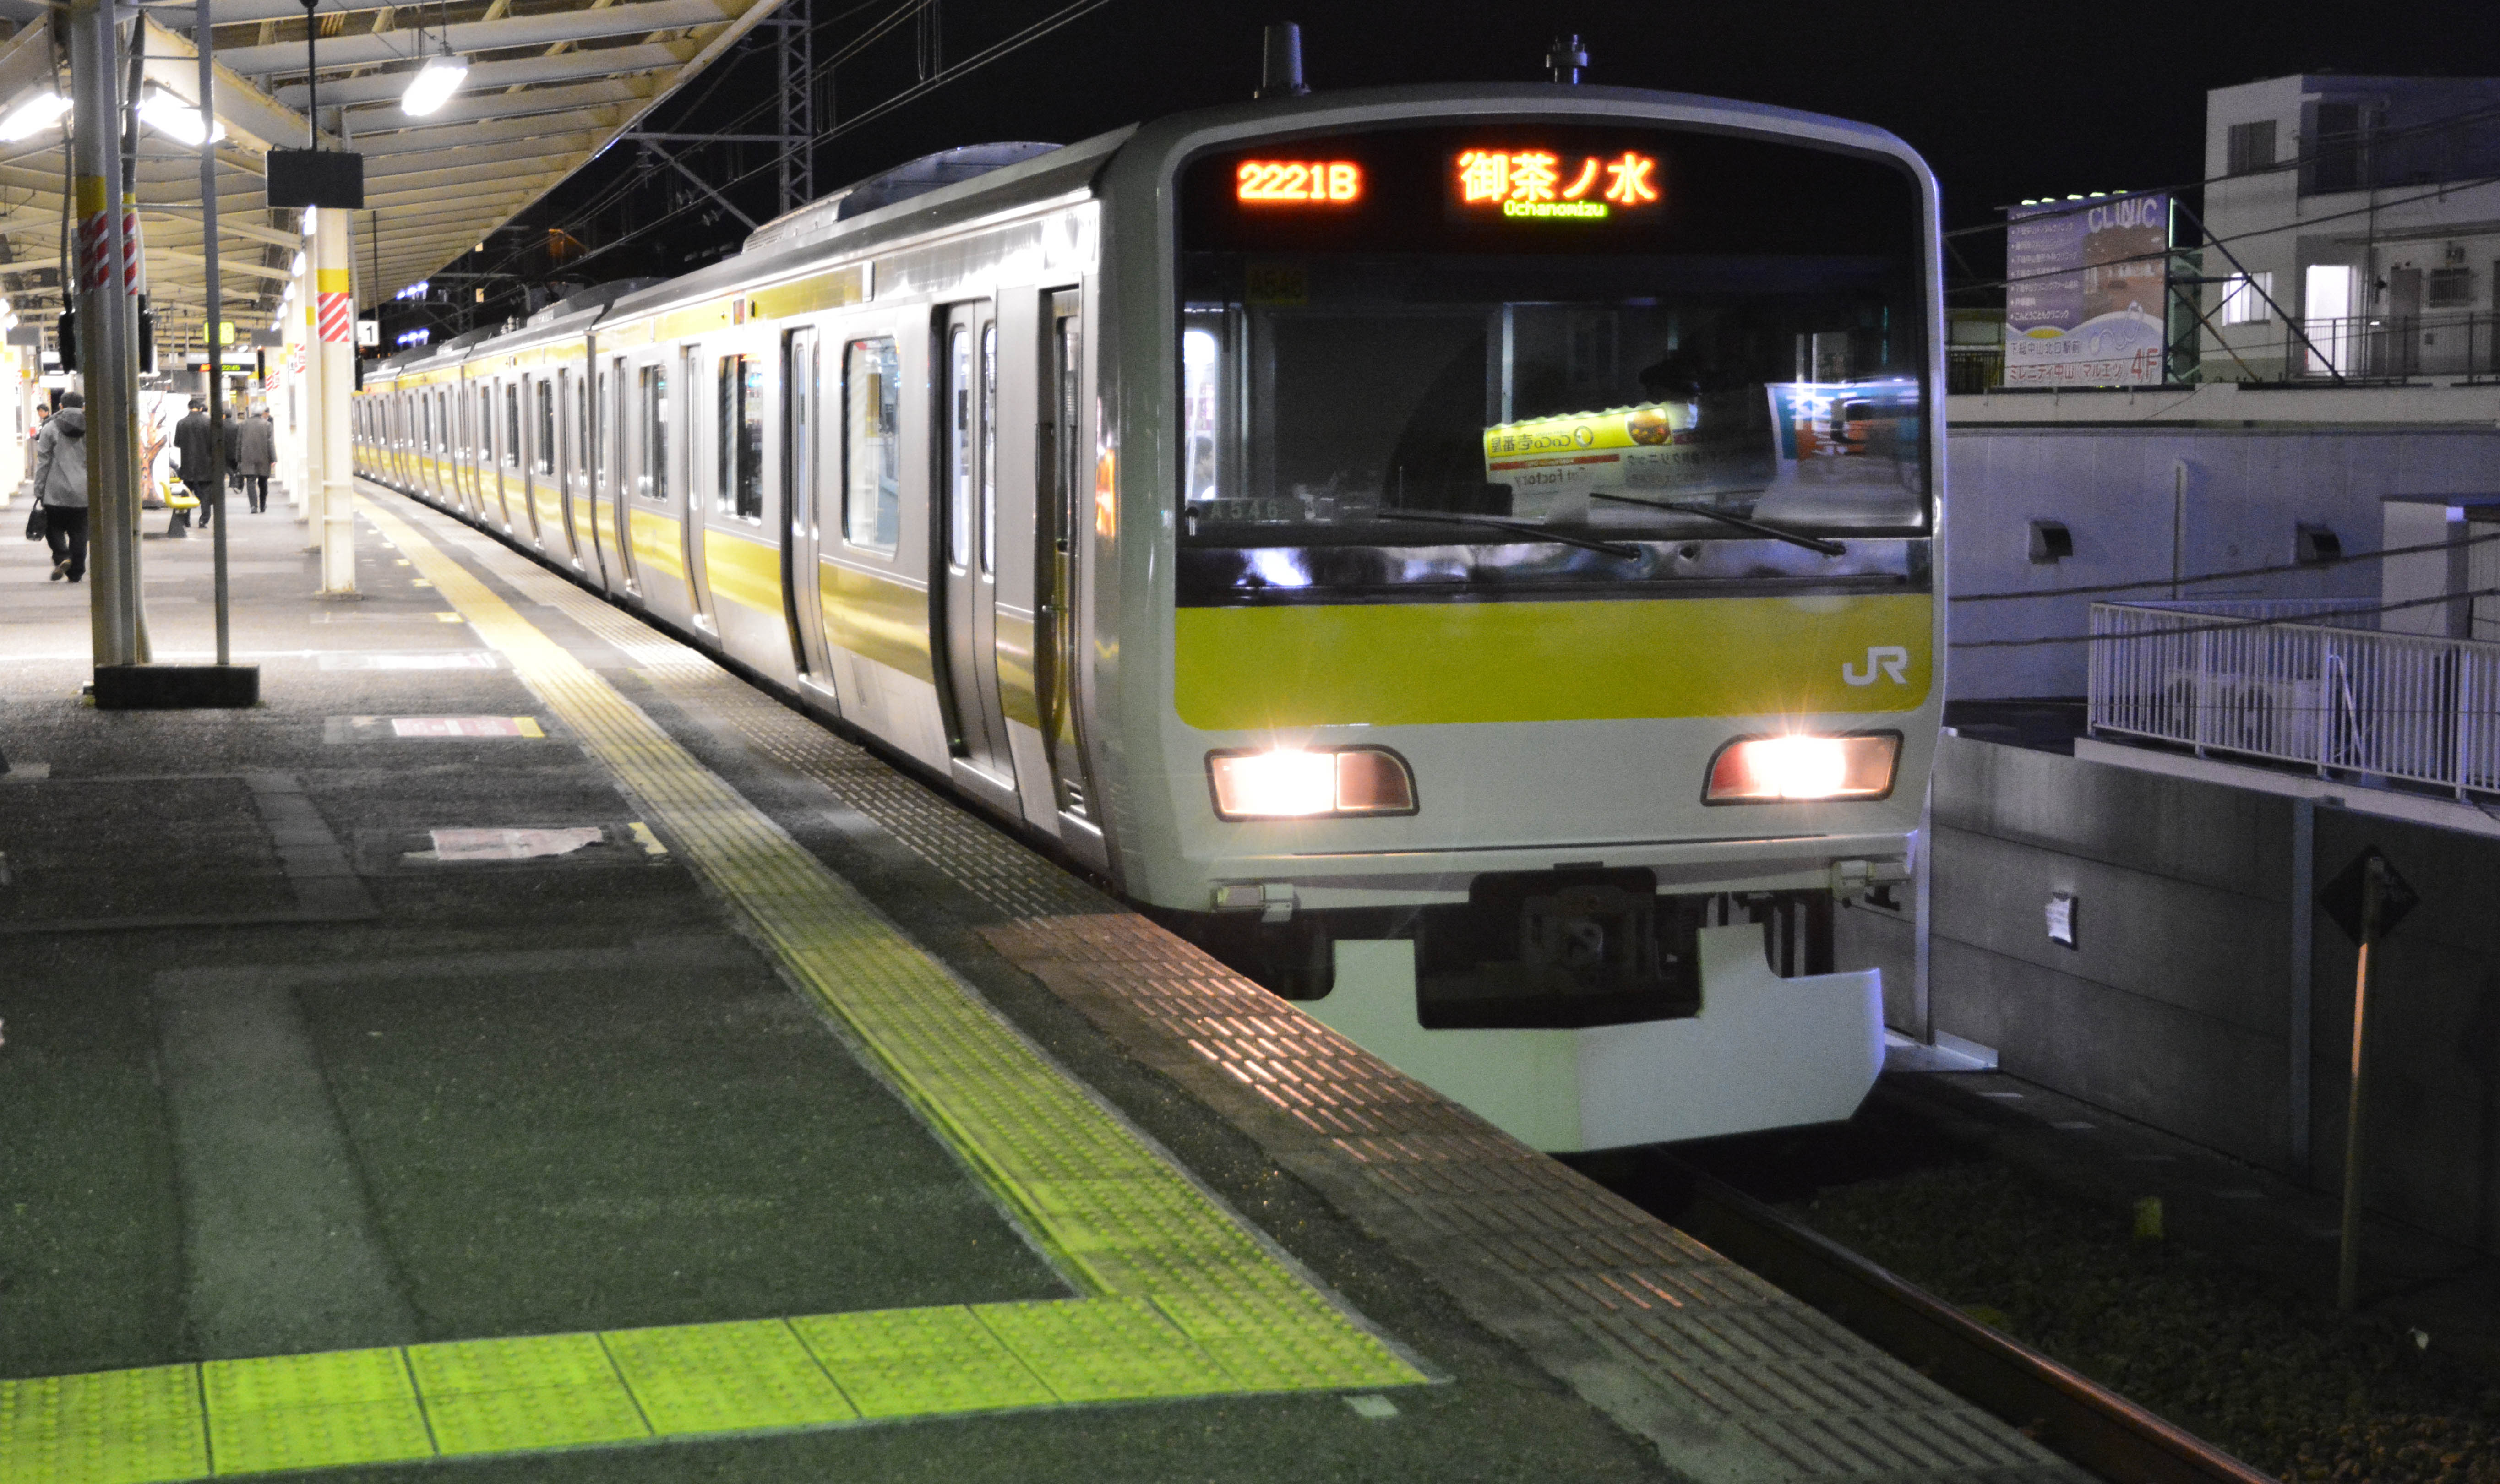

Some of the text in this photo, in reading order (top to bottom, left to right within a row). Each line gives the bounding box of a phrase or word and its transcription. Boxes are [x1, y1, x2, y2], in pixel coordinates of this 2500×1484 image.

[1238, 163, 1358, 200] 2221B
[1459, 152, 1657, 203] 御茶ノ水
[1503, 200, 1605, 216] Ochanomizu
[2088, 198, 2157, 233] CLINIC
[1842, 646, 1908, 686] JR
